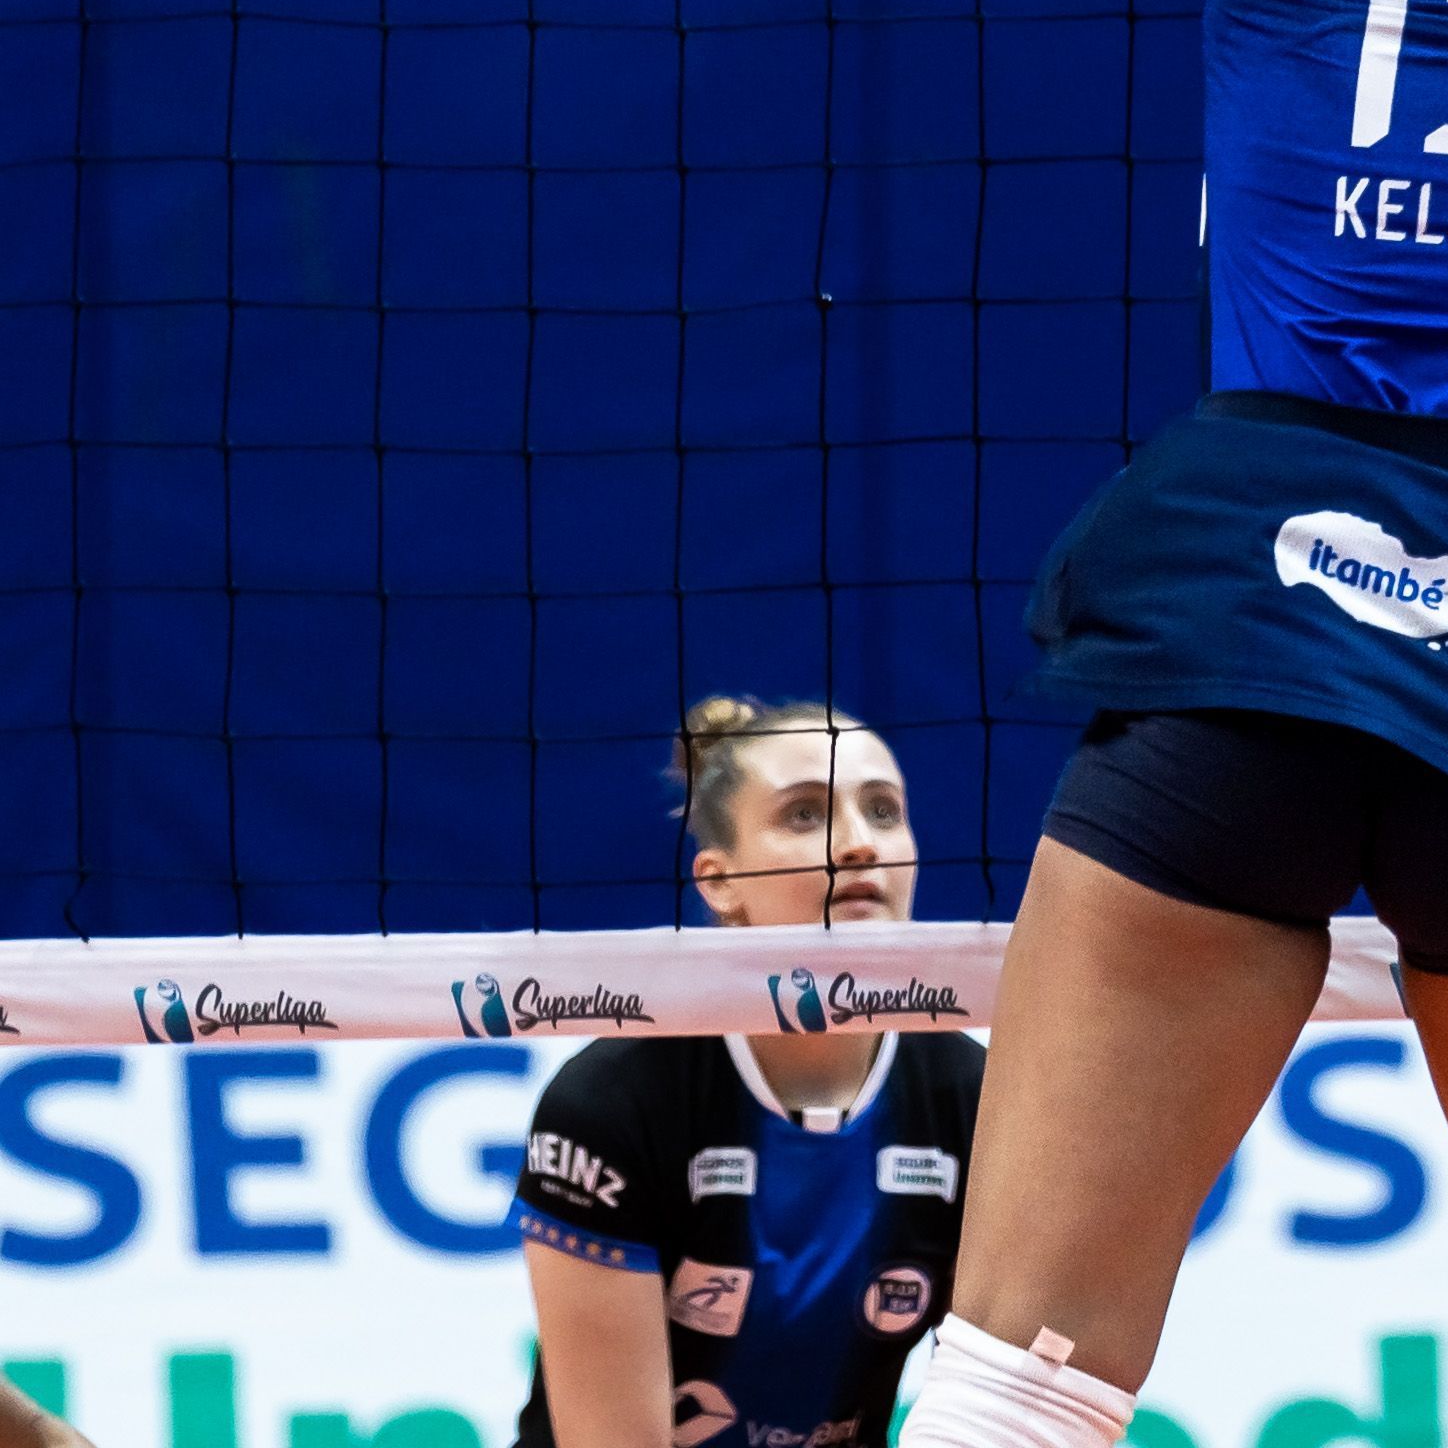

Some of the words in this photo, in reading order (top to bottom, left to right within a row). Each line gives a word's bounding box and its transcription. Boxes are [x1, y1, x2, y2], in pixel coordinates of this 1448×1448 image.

[1308, 537, 1447, 611] itambé
[195, 983, 339, 1035] Superliga
[511, 978, 656, 1030] Superliga
[826, 971, 971, 1024] Superliga
[527, 1131, 627, 1209] HEINZ
